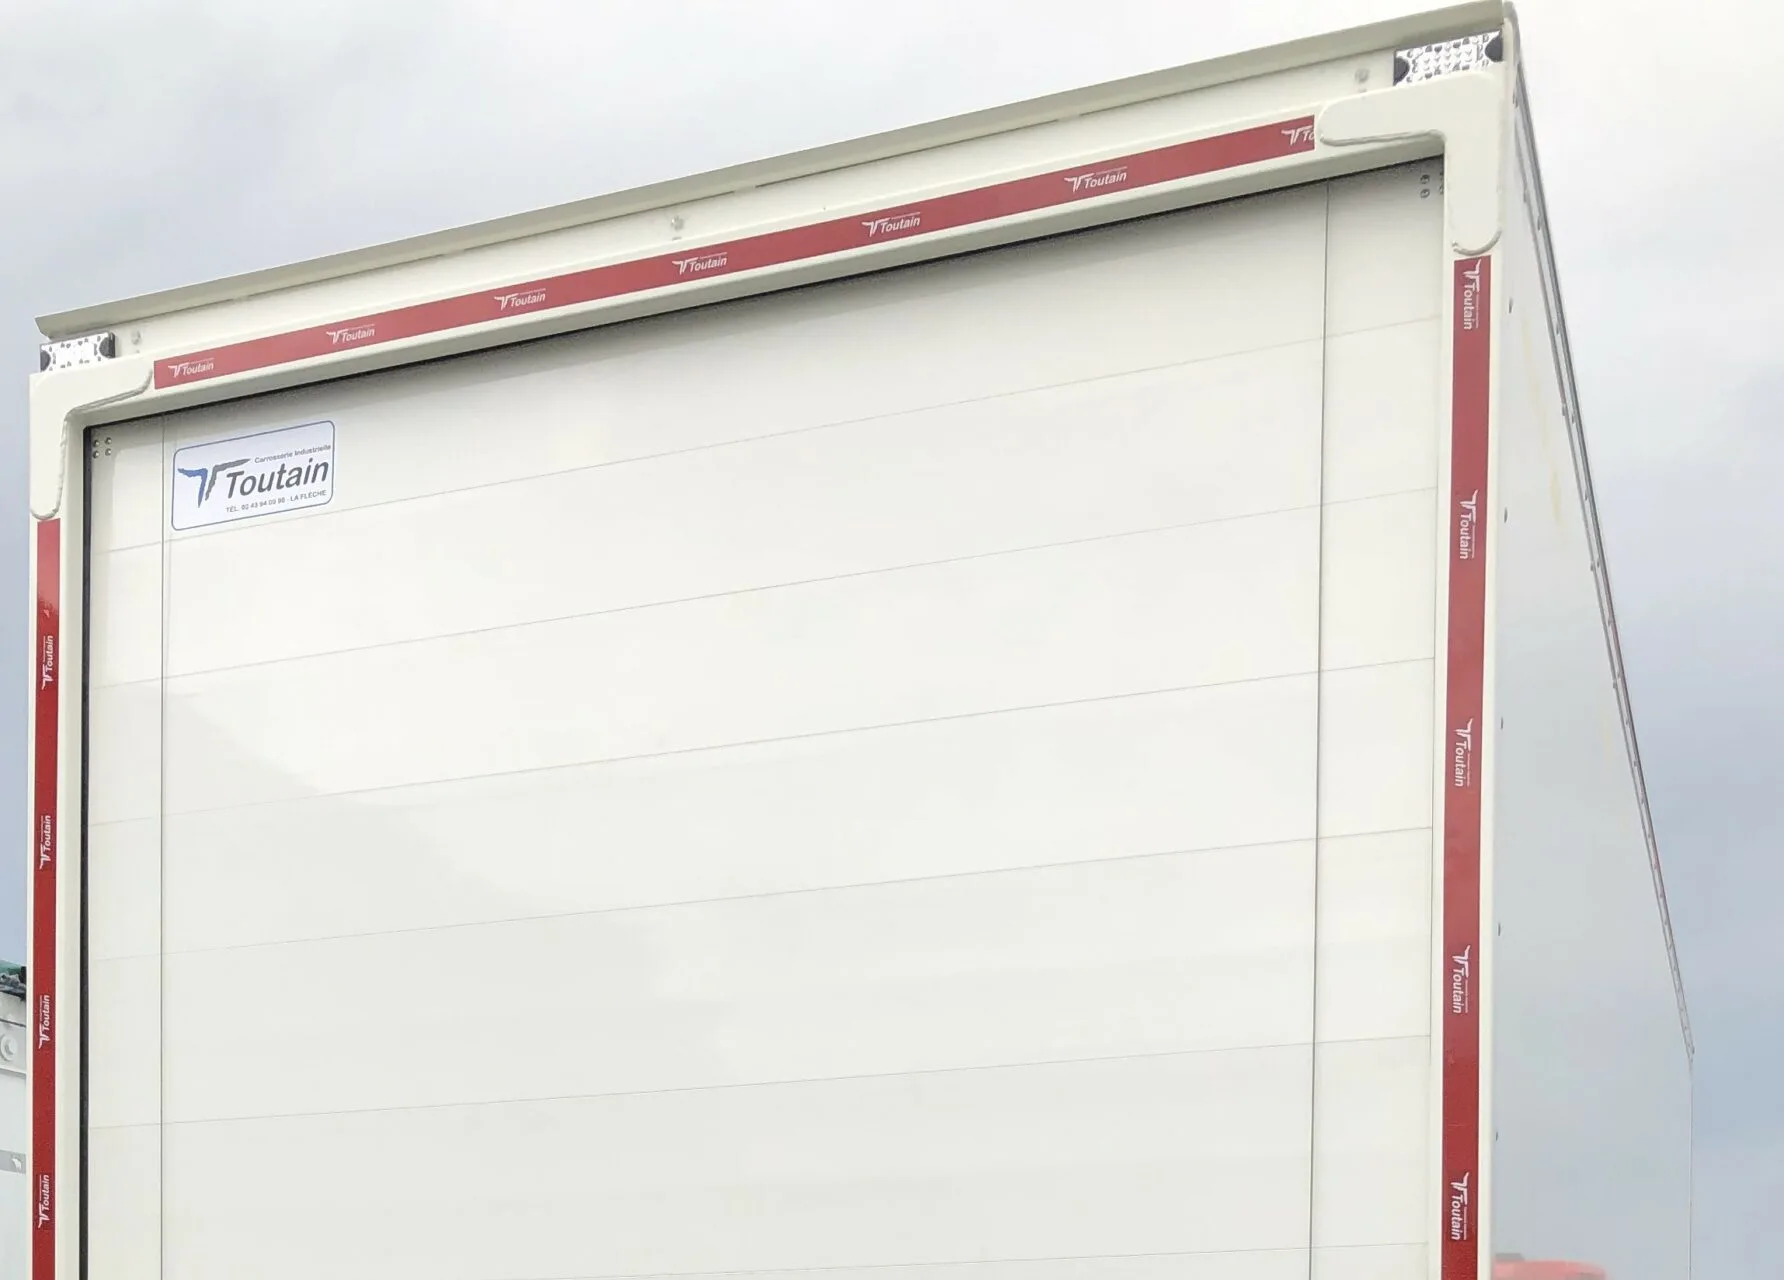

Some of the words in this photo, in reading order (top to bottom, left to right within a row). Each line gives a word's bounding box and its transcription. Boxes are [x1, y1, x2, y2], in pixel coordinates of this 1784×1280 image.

[1085, 173, 1127, 188] Toutain
[881, 217, 920, 232] Toutain
[690, 257, 726, 271] Toutain
[510, 293, 545, 307] Toutain
[1463, 283, 1475, 330] Toutain
[342, 329, 374, 343] Toutain
[182, 362, 214, 375] Toutain
[226, 457, 329, 499] Toutain
[1459, 512, 1471, 559] Toutain
[45, 635, 53, 672] Toutain
[1454, 740, 1467, 787] Toutain
[43, 815, 51, 852] Toutain
[1453, 968, 1465, 1014] Toutain
[41, 994, 50, 1031] Toutain
[41, 1174, 49, 1211] Toutain
[1451, 1193, 1463, 1241] Toutain
